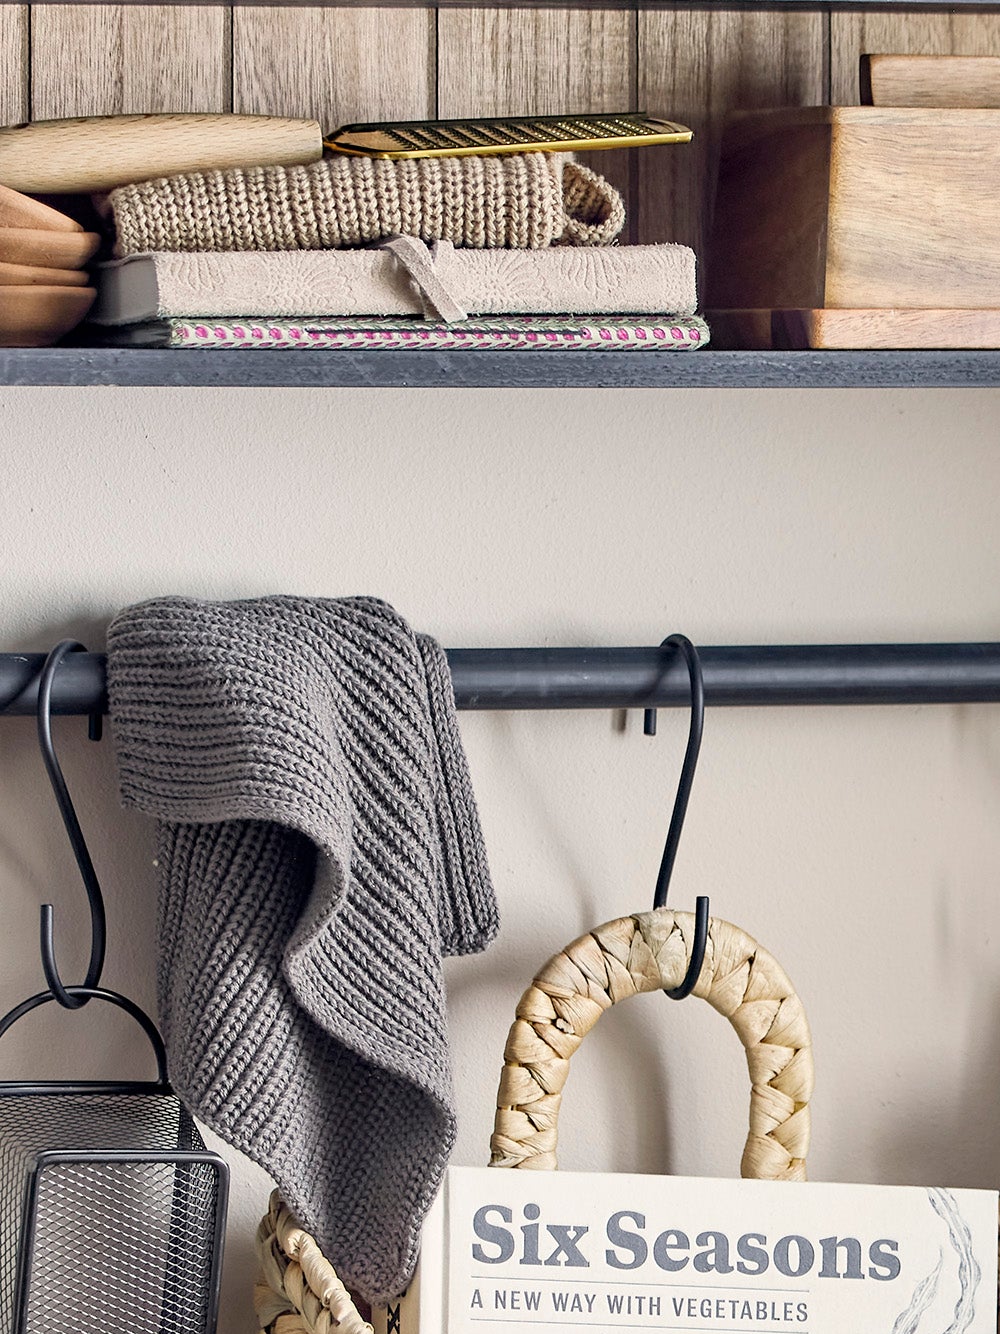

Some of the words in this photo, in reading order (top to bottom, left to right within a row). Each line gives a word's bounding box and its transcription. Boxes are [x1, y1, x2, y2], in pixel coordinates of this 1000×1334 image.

[470, 1203, 591, 1268] Six
[605, 1210, 902, 1282] Seasons
[470, 1288, 484, 1309] A
[494, 1289, 542, 1311] NEW
[551, 1292, 597, 1313] WAY
[606, 1294, 662, 1317] WITH
[672, 1297, 809, 1323] VEGETABLES
